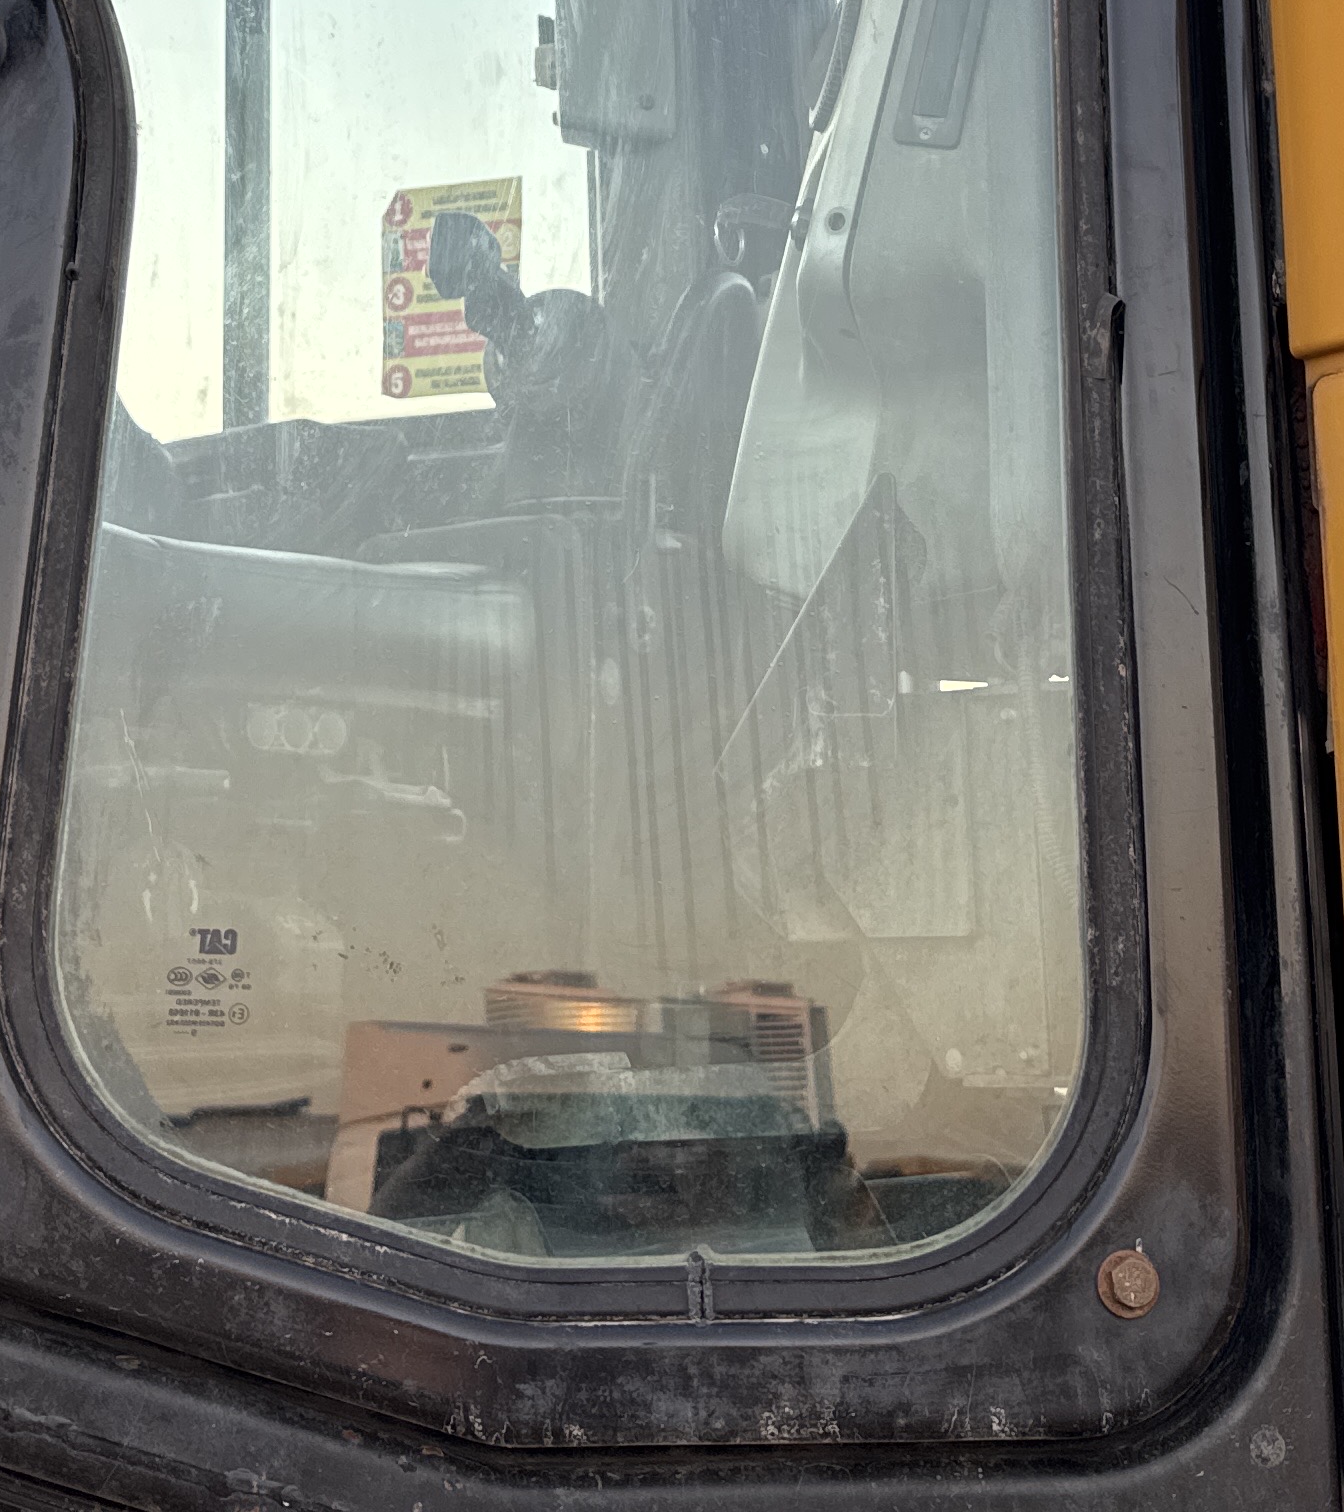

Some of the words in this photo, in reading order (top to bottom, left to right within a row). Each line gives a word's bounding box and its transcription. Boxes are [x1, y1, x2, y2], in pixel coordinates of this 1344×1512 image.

[393, 200, 404, 221] 1
[393, 282, 406, 305] 3
[391, 372, 404, 394] 5
